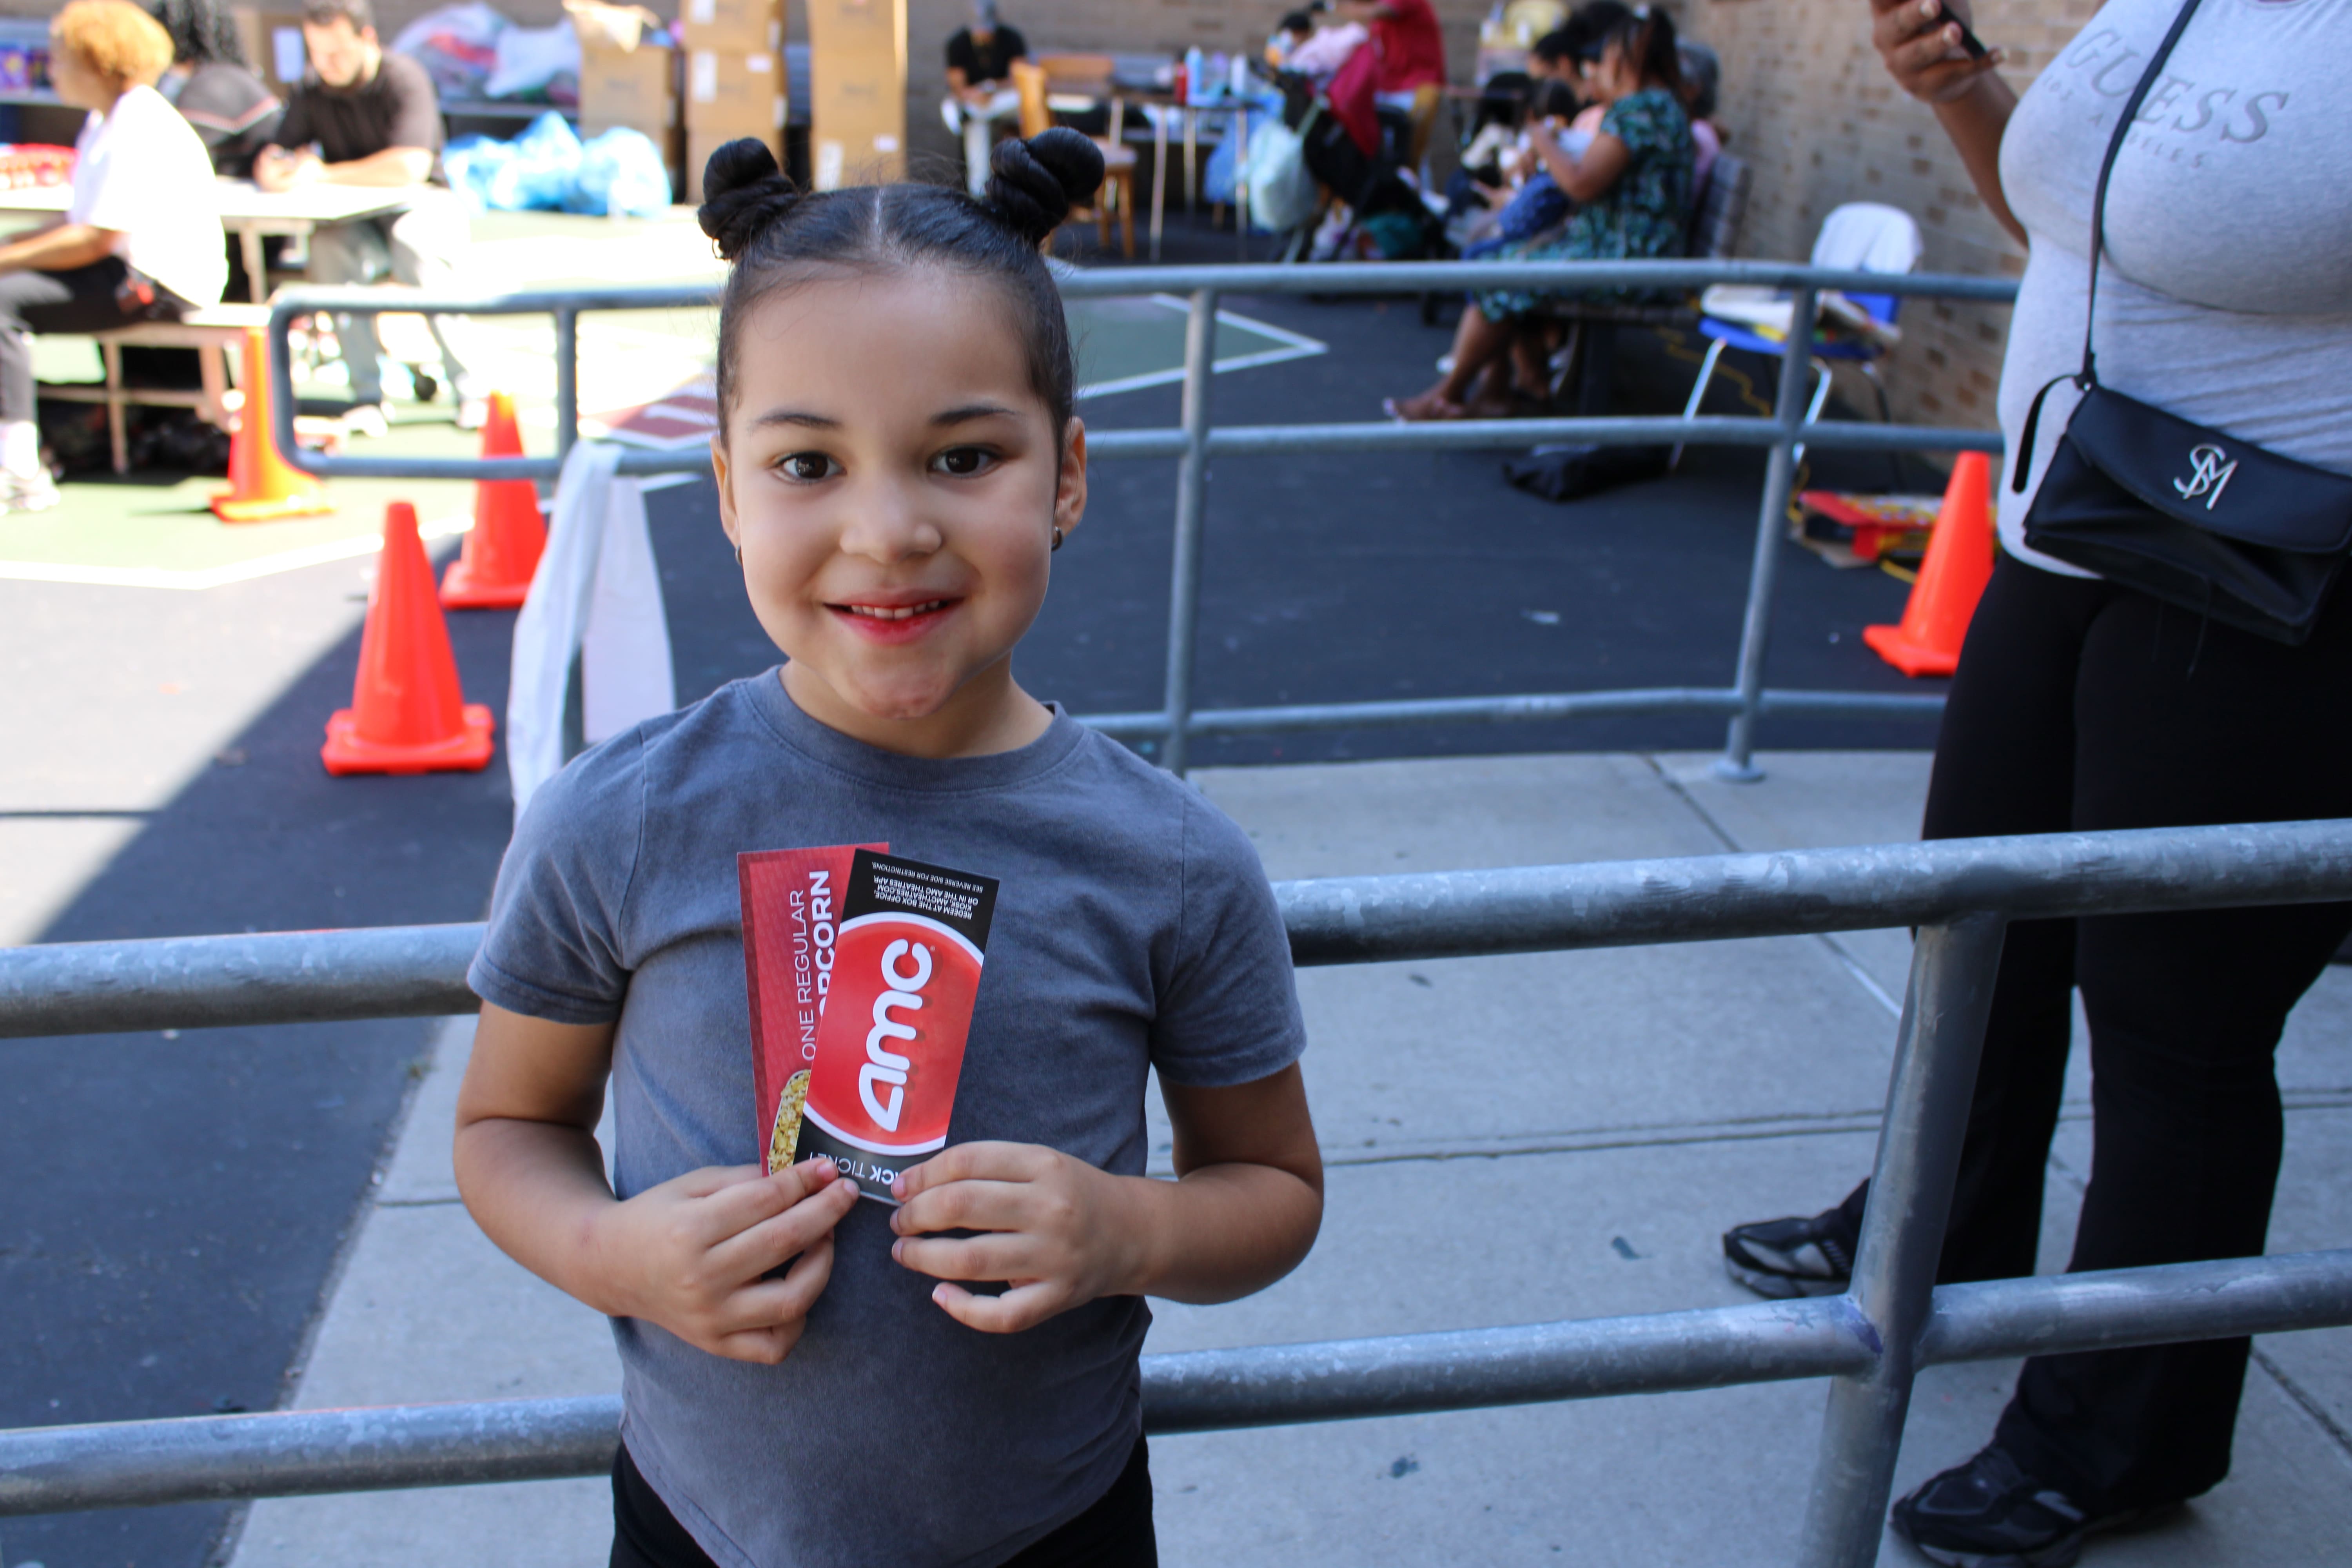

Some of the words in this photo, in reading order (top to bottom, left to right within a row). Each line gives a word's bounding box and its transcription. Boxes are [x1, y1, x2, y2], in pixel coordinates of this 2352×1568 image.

[2065, 28, 2290, 143] GUESS
[916, 871, 929, 882] FOR
[930, 875, 944, 885] SIDE
[889, 878, 924, 894] THEATRES
[944, 878, 971, 891] REVERSE
[972, 884, 983, 893] SEE
[926, 887, 944, 898] AMC
[944, 891, 957, 902] THE
[902, 897, 917, 907] BOX
[959, 894, 967, 904] IN
[967, 897, 978, 906] OR
[918, 900, 932, 911] THE
[933, 904, 943, 913] AT
[944, 906, 972, 920] REDEEM
[789, 889, 812, 1004] REGULAR
[799, 1009, 816, 1061] ONE
[858, 938, 933, 1132] amc
